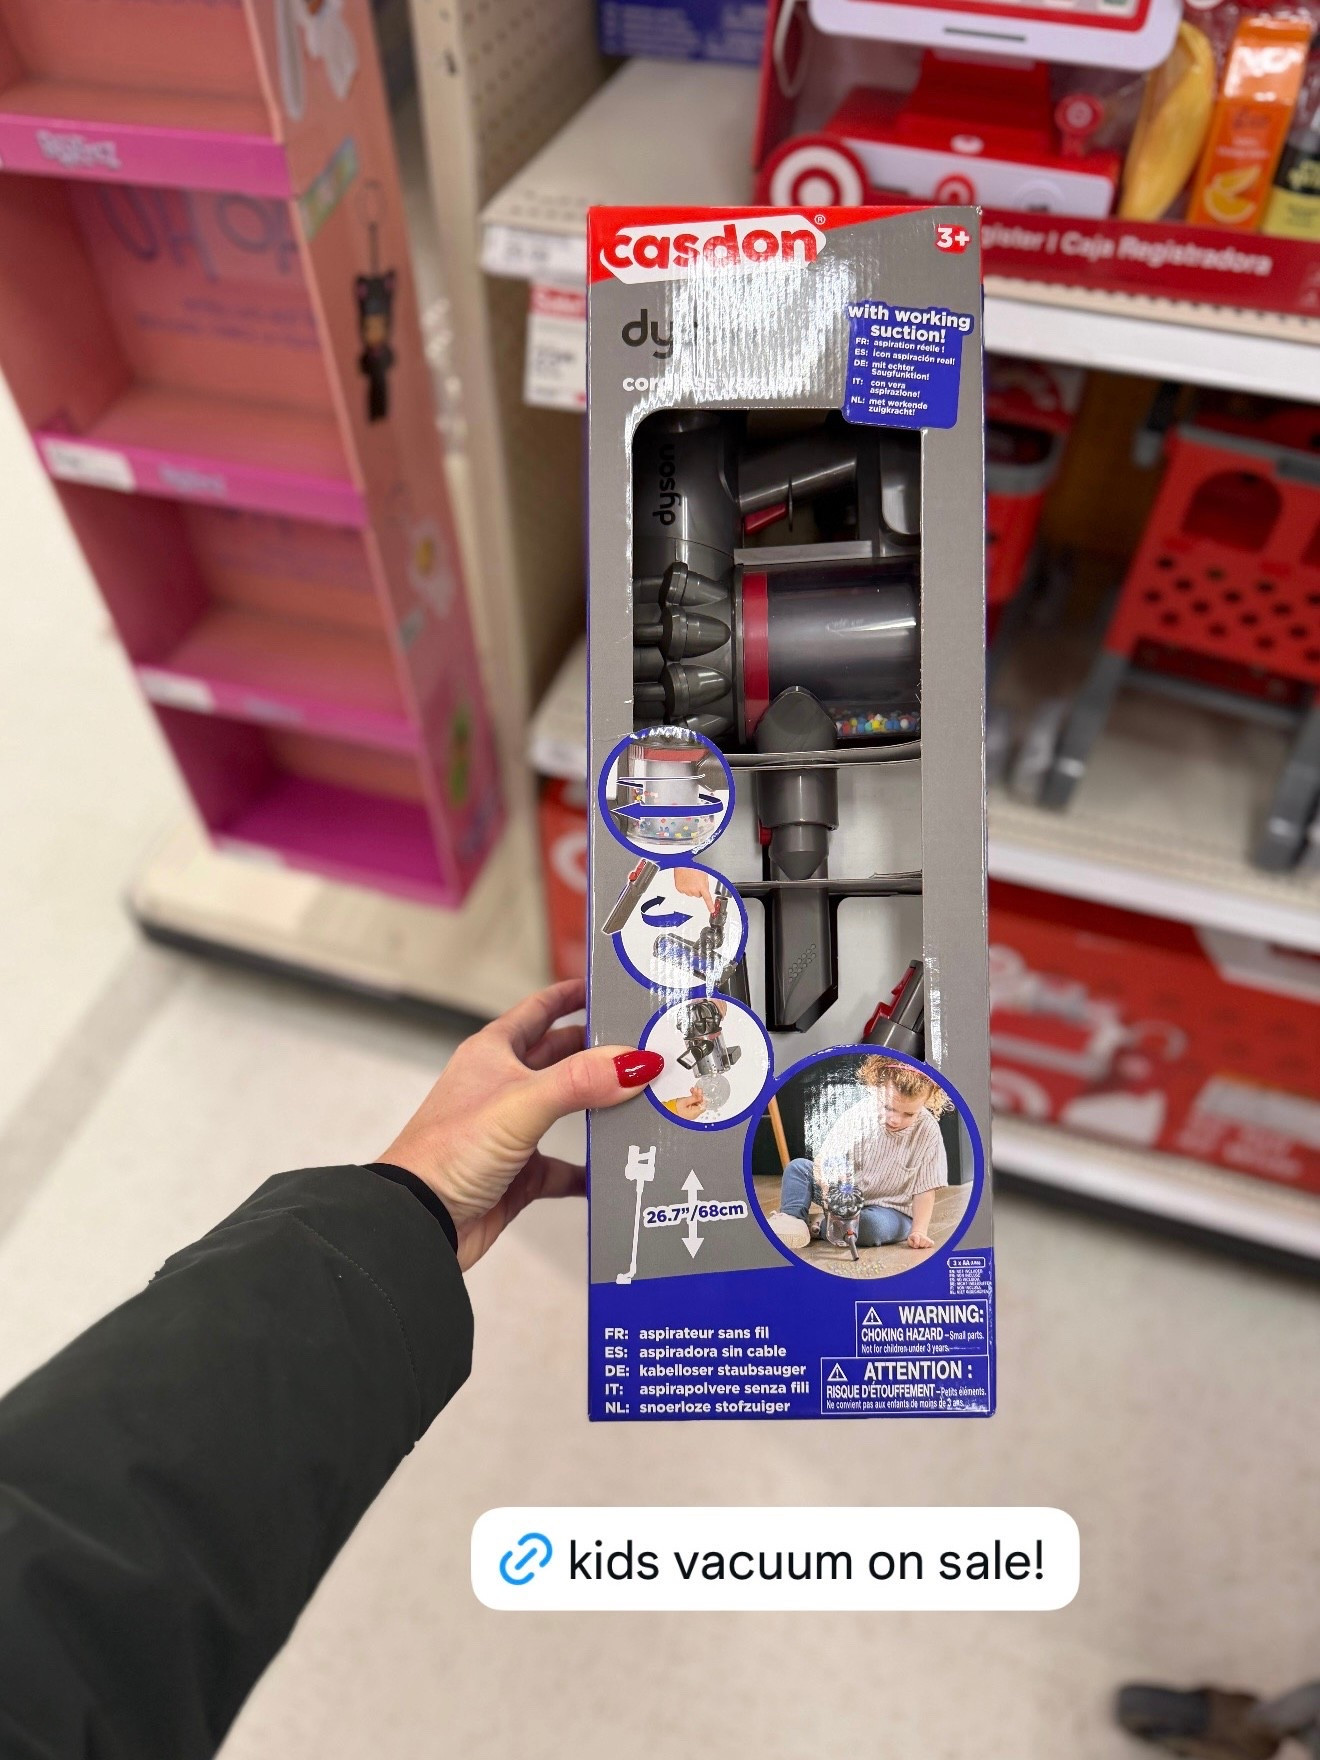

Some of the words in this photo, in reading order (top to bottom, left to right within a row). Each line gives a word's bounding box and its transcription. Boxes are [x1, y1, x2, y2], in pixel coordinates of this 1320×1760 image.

[937, 227, 970, 248] 3+
[982, 224, 1045, 251] gister
[604, 224, 818, 269] casdon
[848, 304, 889, 321] with
[894, 310, 971, 331] working
[870, 324, 946, 343] suction!
[855, 337, 869, 345] FR:
[873, 340, 915, 350] aspiration
[854, 348, 868, 356] ES:
[893, 352, 935, 363] aspiración
[854, 359, 868, 367] DE:
[888, 363, 914, 371] echter
[871, 369, 930, 380] Saugfunktion!
[870, 388, 920, 398] aspirazione!
[851, 396, 865, 404] NL:
[869, 398, 885, 406] met
[888, 400, 928, 410] werkende
[868, 406, 916, 416] zuigkracht!
[652, 443, 682, 526] dyson
[898, 1304, 984, 1324] WARNING:
[604, 1327, 629, 1340] FR:
[639, 1327, 715, 1341] aspirateur
[718, 1328, 751, 1339] sans
[755, 1326, 770, 1339] fil
[861, 1327, 904, 1342] CHOKING
[906, 1327, 944, 1341] HAZARD
[967, 1330, 985, 1342] parts.
[604, 1346, 628, 1359] ES:
[639, 1345, 718, 1360] aspiradora
[721, 1345, 743, 1357] sin
[746, 1345, 787, 1357] cable
[861, 1343, 873, 1353] Not
[874, 1343, 882, 1353] for
[883, 1343, 908, 1353] children
[908, 1343, 925, 1353] under
[926, 1343, 931, 1352] 3
[604, 1365, 630, 1377] DE:
[639, 1364, 714, 1377] kabelloser
[717, 1363, 807, 1378] staubsauger
[864, 1360, 962, 1381] ATTENTION
[605, 1383, 624, 1395] IT:
[639, 1382, 740, 1397] aspirapolvere
[744, 1383, 786, 1394] senza
[790, 1381, 810, 1394] fili
[826, 1384, 860, 1399] RISQUE
[861, 1381, 936, 1398] D'ÉTOUFFEMENT
[605, 1402, 630, 1413] NL:
[639, 1401, 711, 1414] snoerloze
[715, 1400, 791, 1414] stofzuiger
[826, 1400, 835, 1409] Ne
[836, 1399, 862, 1409] convient
[862, 1401, 873, 1410] pas
[874, 1400, 886, 1409] aux
[887, 1399, 910, 1408] enfants
[910, 1399, 919, 1408] de
[919, 1399, 938, 1408] moins
